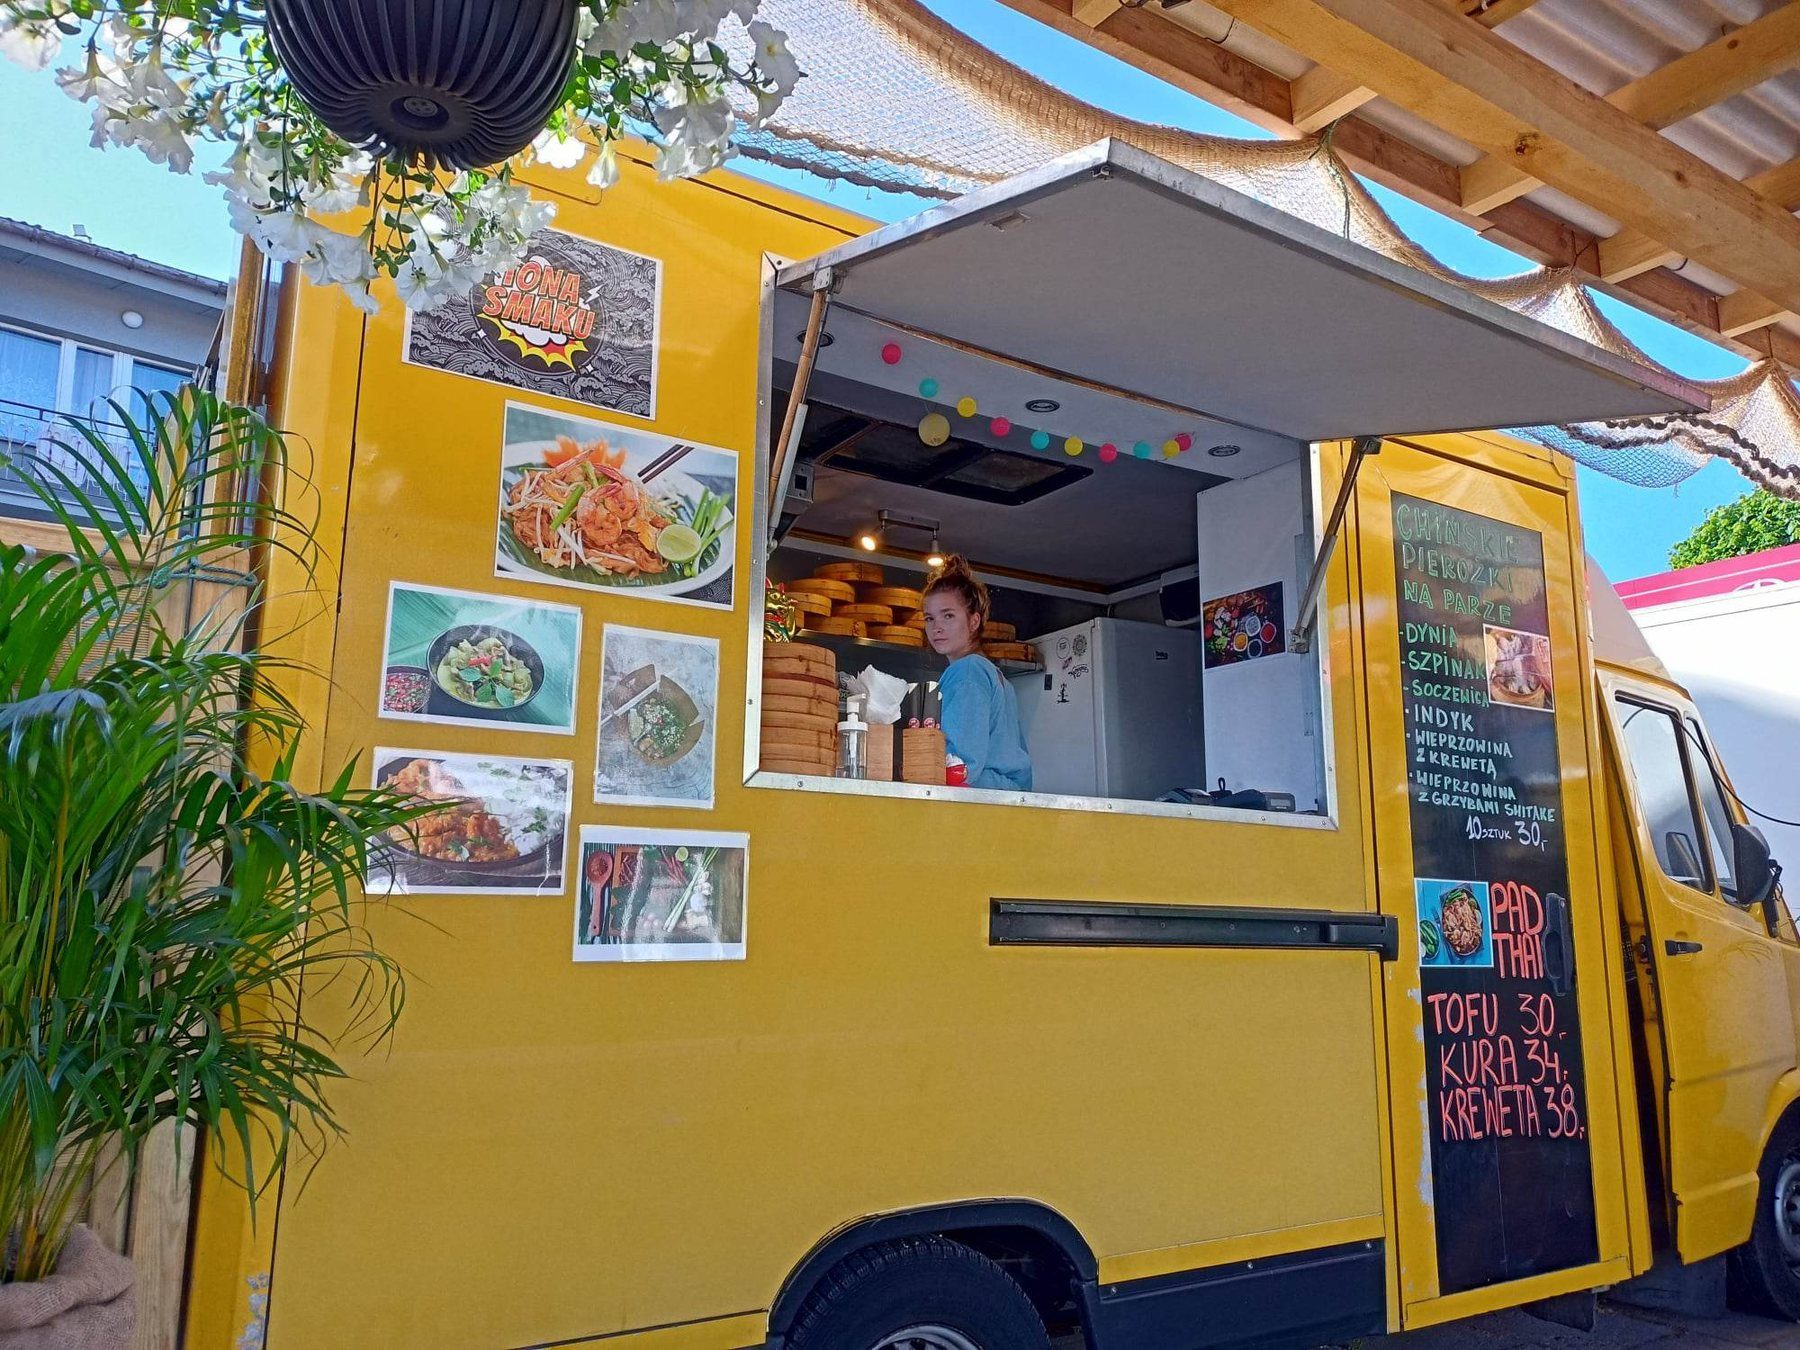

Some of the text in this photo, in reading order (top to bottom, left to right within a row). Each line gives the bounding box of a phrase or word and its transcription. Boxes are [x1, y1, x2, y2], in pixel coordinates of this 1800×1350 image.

[482, 285, 596, 340] SMAKU
[1404, 580, 1511, 624] NA PARZE
[1414, 704, 1475, 732] INDYK
[1415, 729, 1513, 758] WIEPRZOWINA
[1416, 748, 1426, 763] Z
[1416, 770, 1516, 800] WIEPRZOWINA
[1418, 792, 1429, 802] Z
[1431, 791, 1500, 814] GRZYBAMI
[1491, 881, 1544, 935] PAD
[1492, 932, 1544, 980] THAI
[1427, 993, 1499, 1036] TOFU
[1440, 1035, 1518, 1087] KURA
[1440, 1084, 1541, 1142] KREWETA
